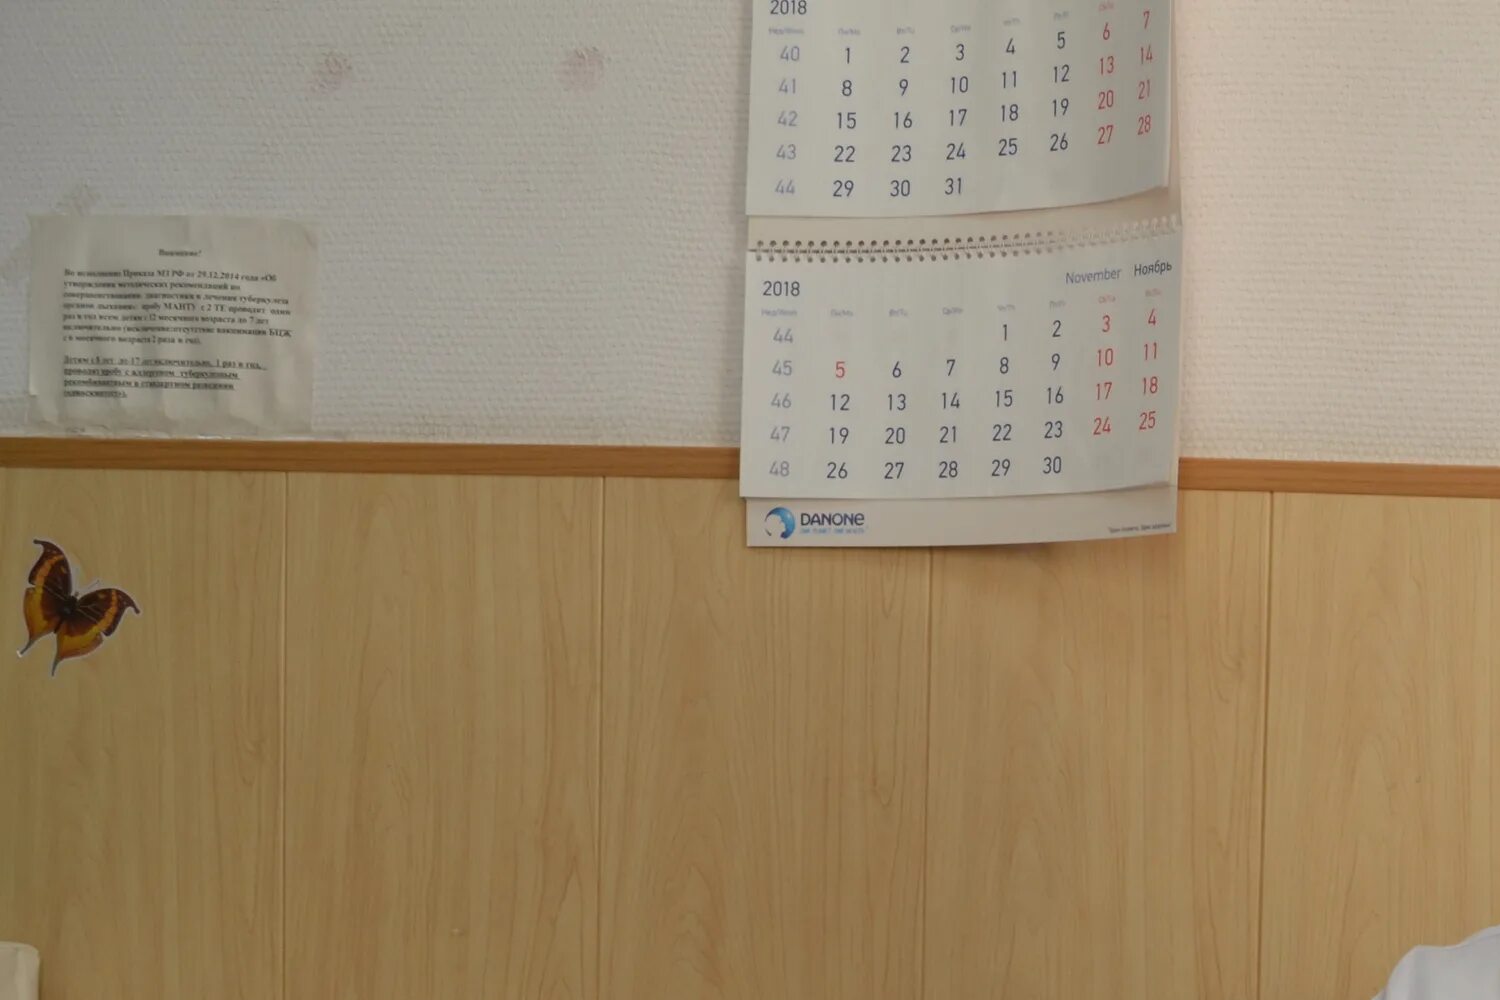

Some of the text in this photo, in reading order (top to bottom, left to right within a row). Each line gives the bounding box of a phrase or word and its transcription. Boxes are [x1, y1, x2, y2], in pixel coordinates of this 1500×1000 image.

[770, 0, 808, 16] 2018
[779, 8, 1151, 65] 40 1 2 3 4 5 6 7
[777, 43, 1154, 98] 41 8 9 10 11 12 13 14
[776, 77, 1152, 130] 42 15 16 17 18 19 20 21
[775, 113, 1152, 163] 43 22 23 24 25 26 27 28
[774, 176, 962, 198] 44 29 30 31
[762, 280, 800, 298] 2018
[1066, 262, 1173, 286] November Ноябрь
[163, 303, 196, 311] МАНТУ
[772, 307, 1157, 344] 44 1 2 3 4
[771, 341, 1158, 380] 45 5 6 7 8 9 10 11
[770, 375, 1159, 412] 46 12 13 14 15 16 17 18
[769, 410, 1157, 445] 47 19 20 21 22 23 24 25
[768, 455, 1062, 480] 48 26 27 28 29 30
